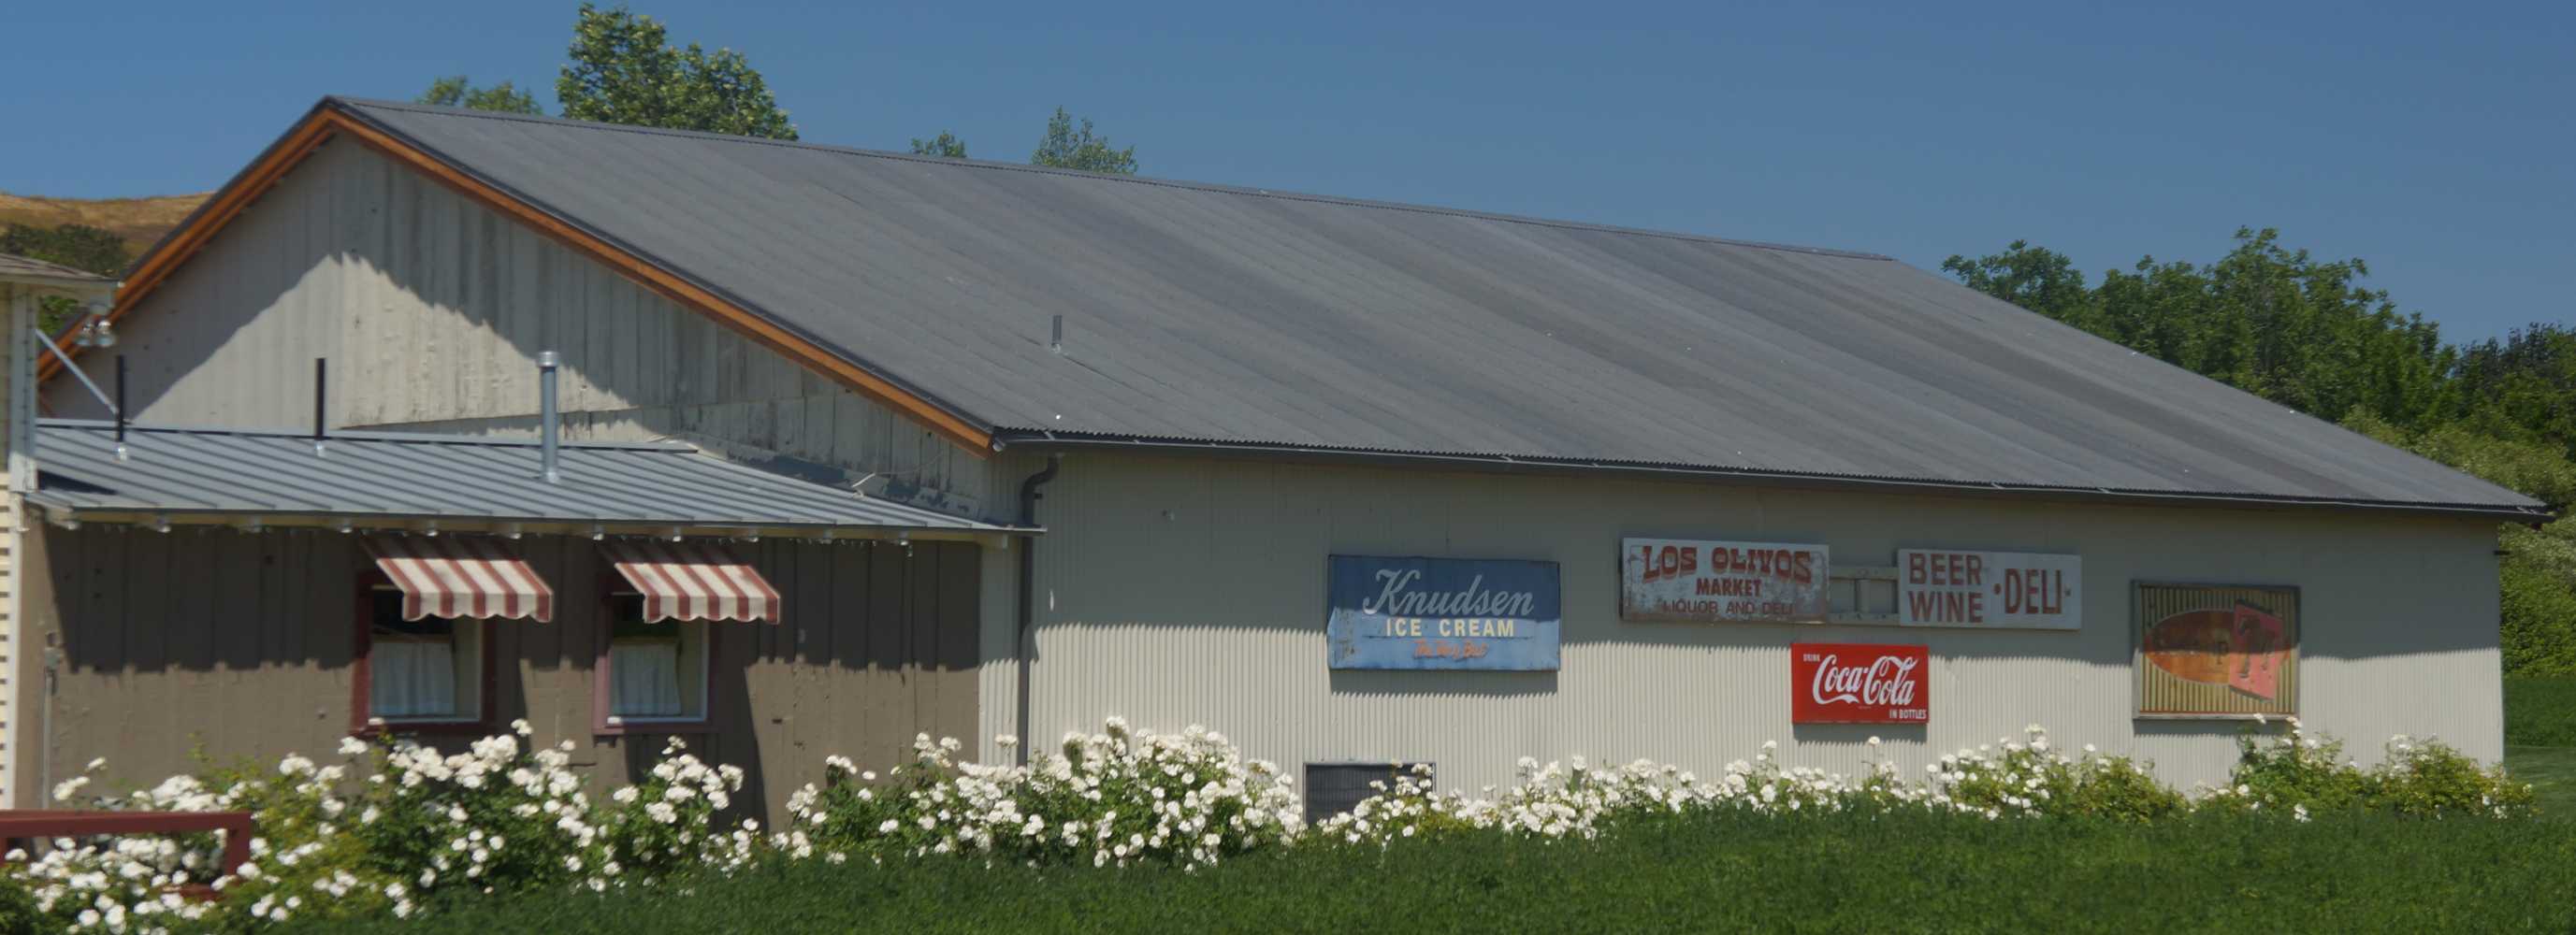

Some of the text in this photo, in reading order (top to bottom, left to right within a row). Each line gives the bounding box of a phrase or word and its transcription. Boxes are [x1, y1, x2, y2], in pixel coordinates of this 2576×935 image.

[1642, 545, 1812, 584] LOS OLIVOS
[1909, 553, 1982, 586] BEER
[1362, 568, 1535, 616] Knudsen
[1695, 578, 1762, 597] MARKET
[2004, 568, 2062, 614] DELI
[1660, 598, 1795, 615] LIQUOR AND DELI
[1907, 590, 1983, 623] WINE
[1386, 618, 1514, 637] ICE CREAM
[1812, 654, 1919, 705] Coca-Cola
[1889, 709, 1927, 719] IN BOTTLES
